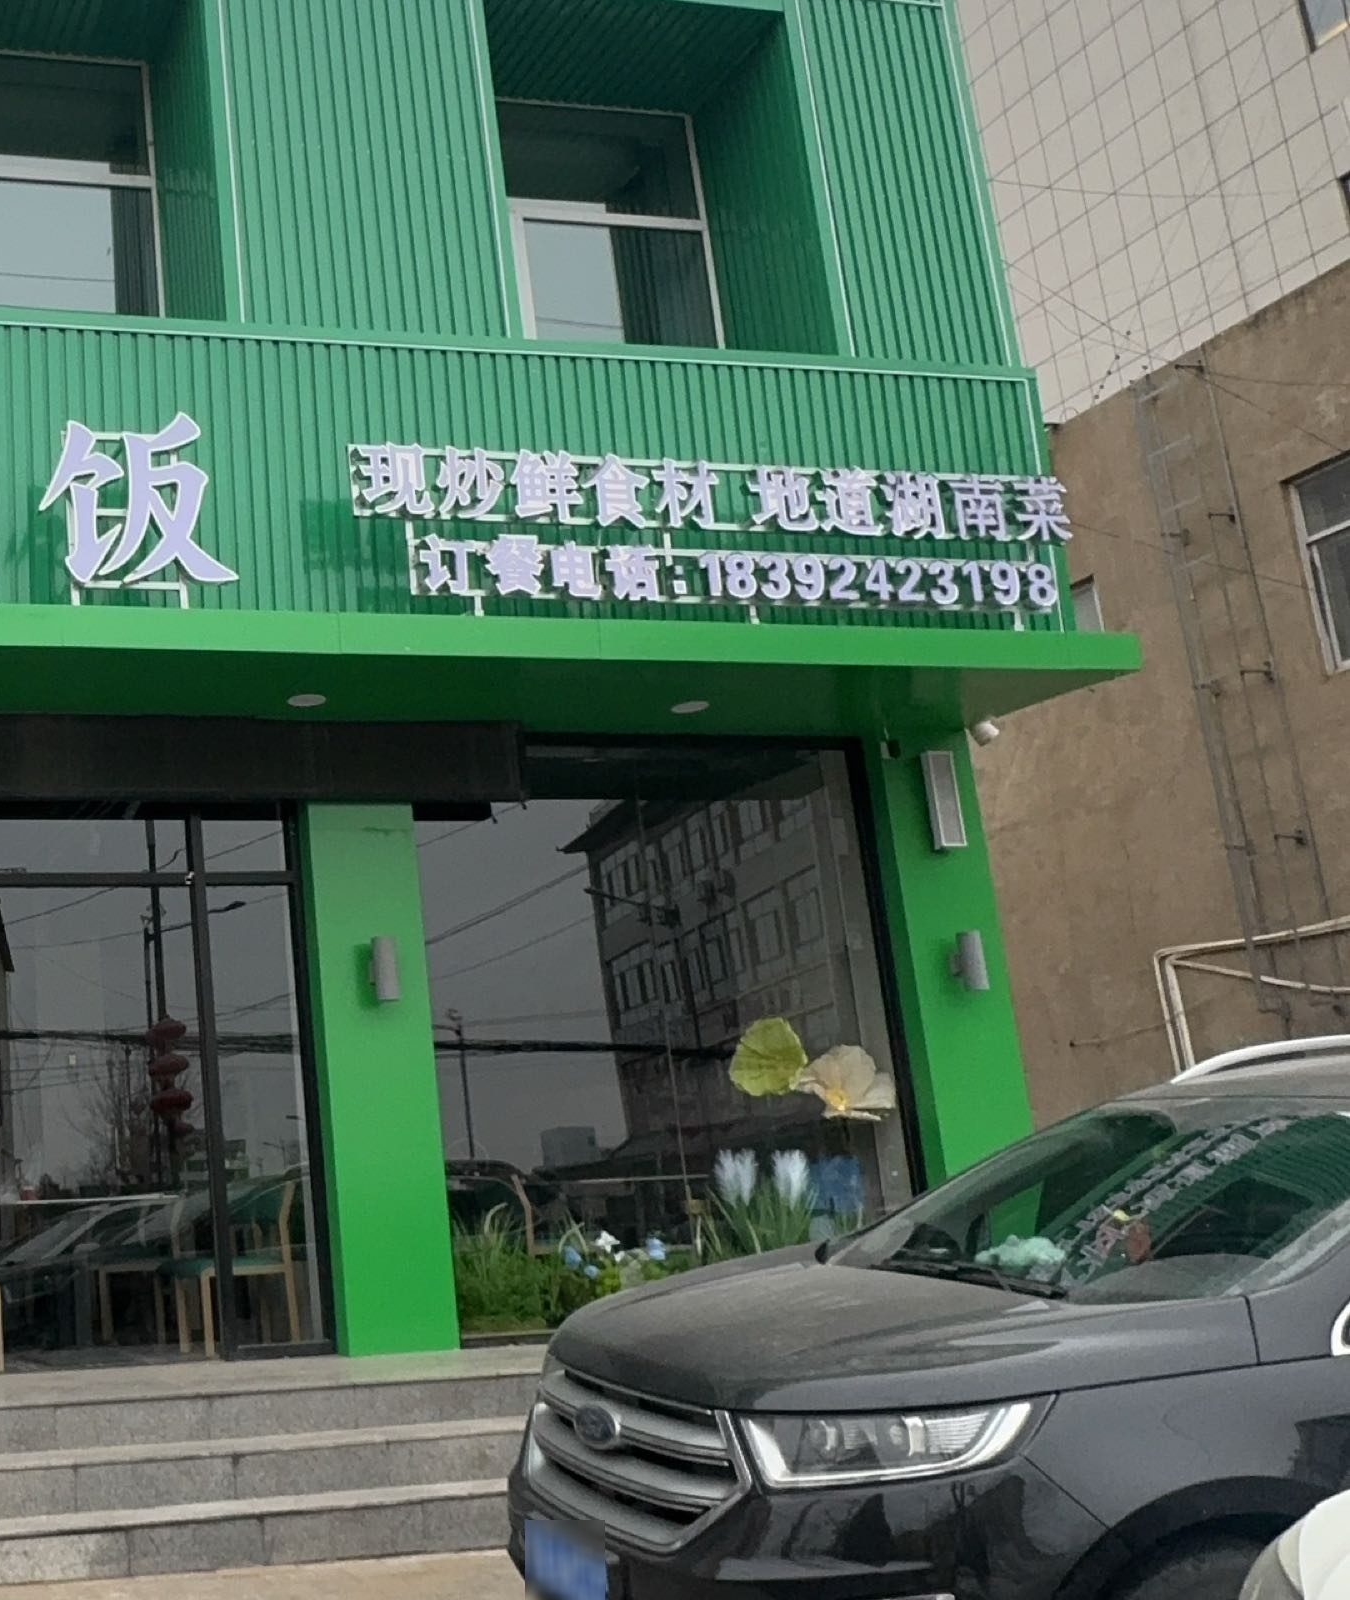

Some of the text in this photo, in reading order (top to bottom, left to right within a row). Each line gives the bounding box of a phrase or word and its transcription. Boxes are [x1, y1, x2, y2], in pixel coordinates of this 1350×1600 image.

[357, 441, 1073, 545] 现炒鲜食材 地道湖南菜
